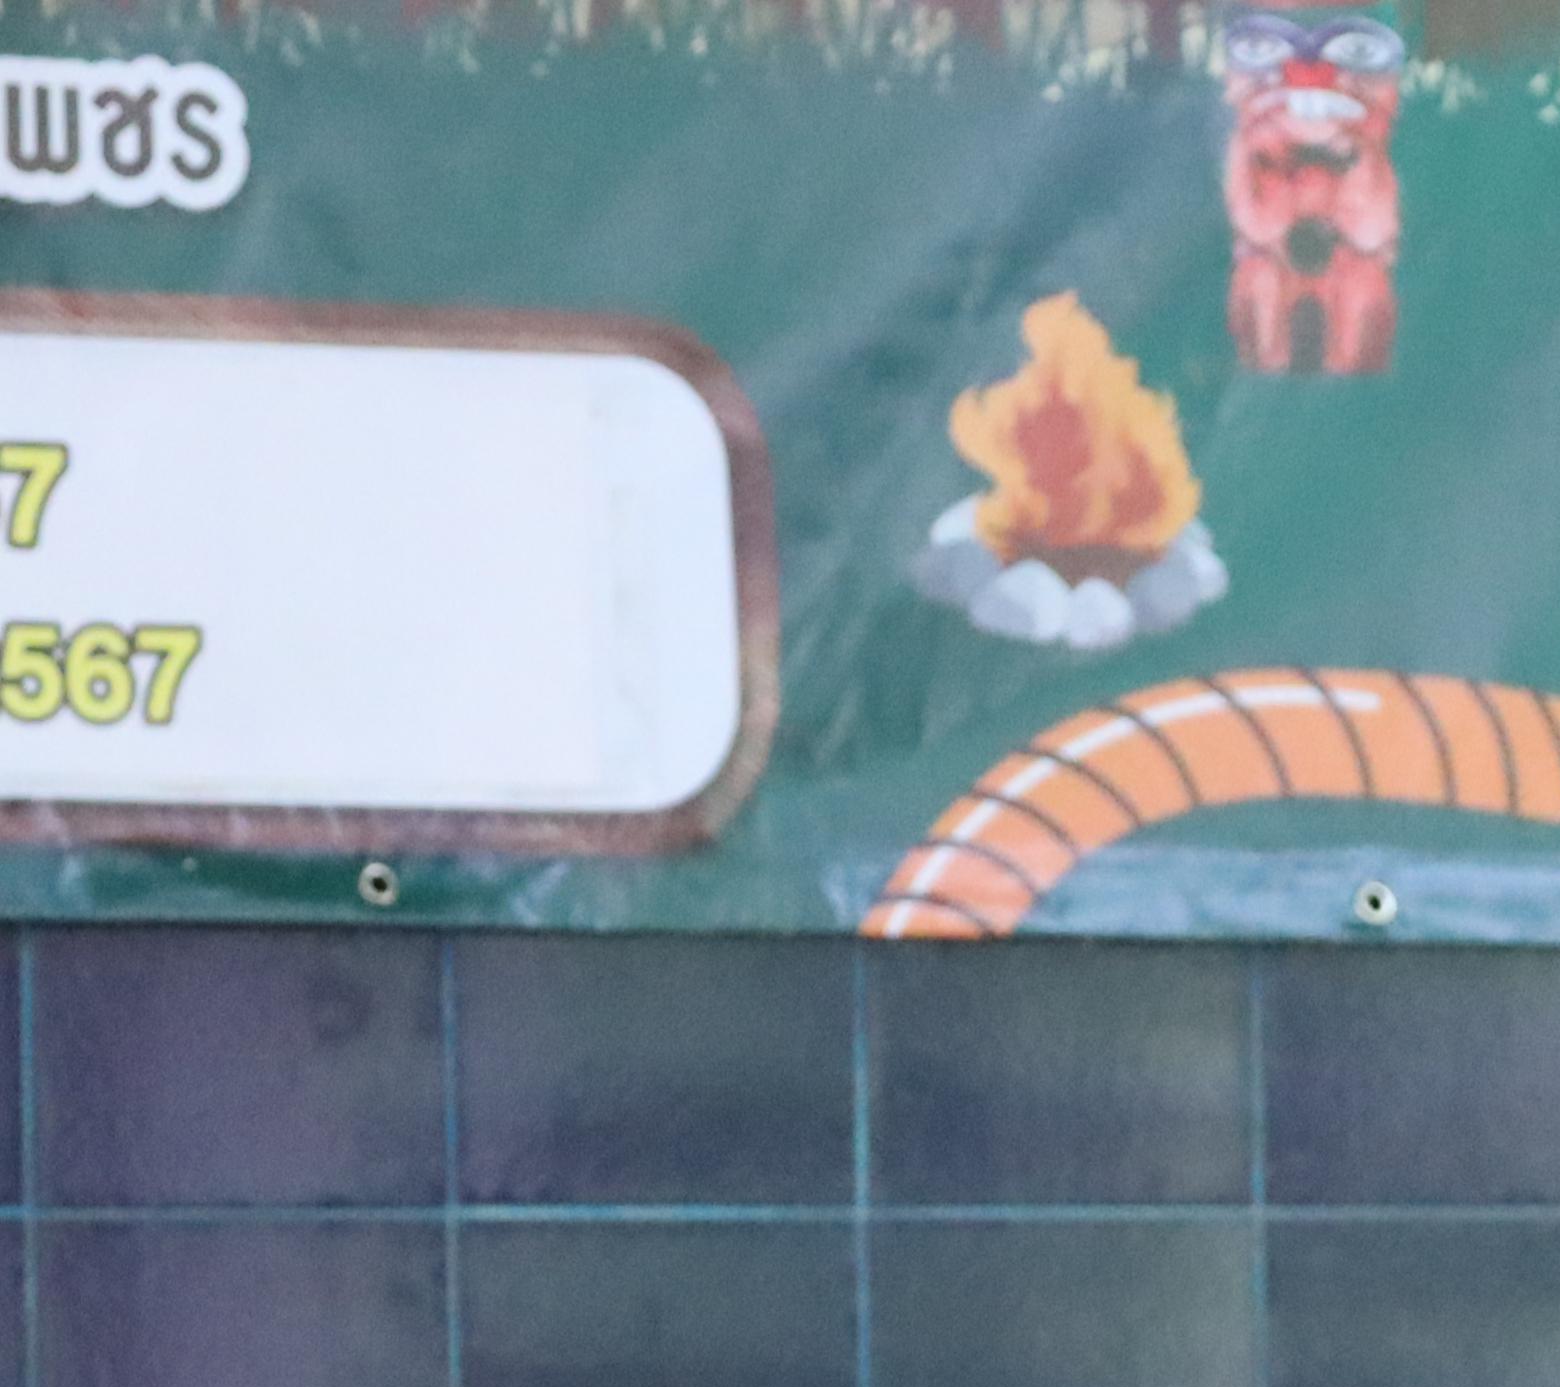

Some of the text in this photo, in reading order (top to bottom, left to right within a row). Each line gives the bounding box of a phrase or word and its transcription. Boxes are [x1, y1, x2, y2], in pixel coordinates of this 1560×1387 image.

[7, 82, 222, 180] พชร
[0, 442, 68, 548] 7
[0, 620, 203, 725] 567
